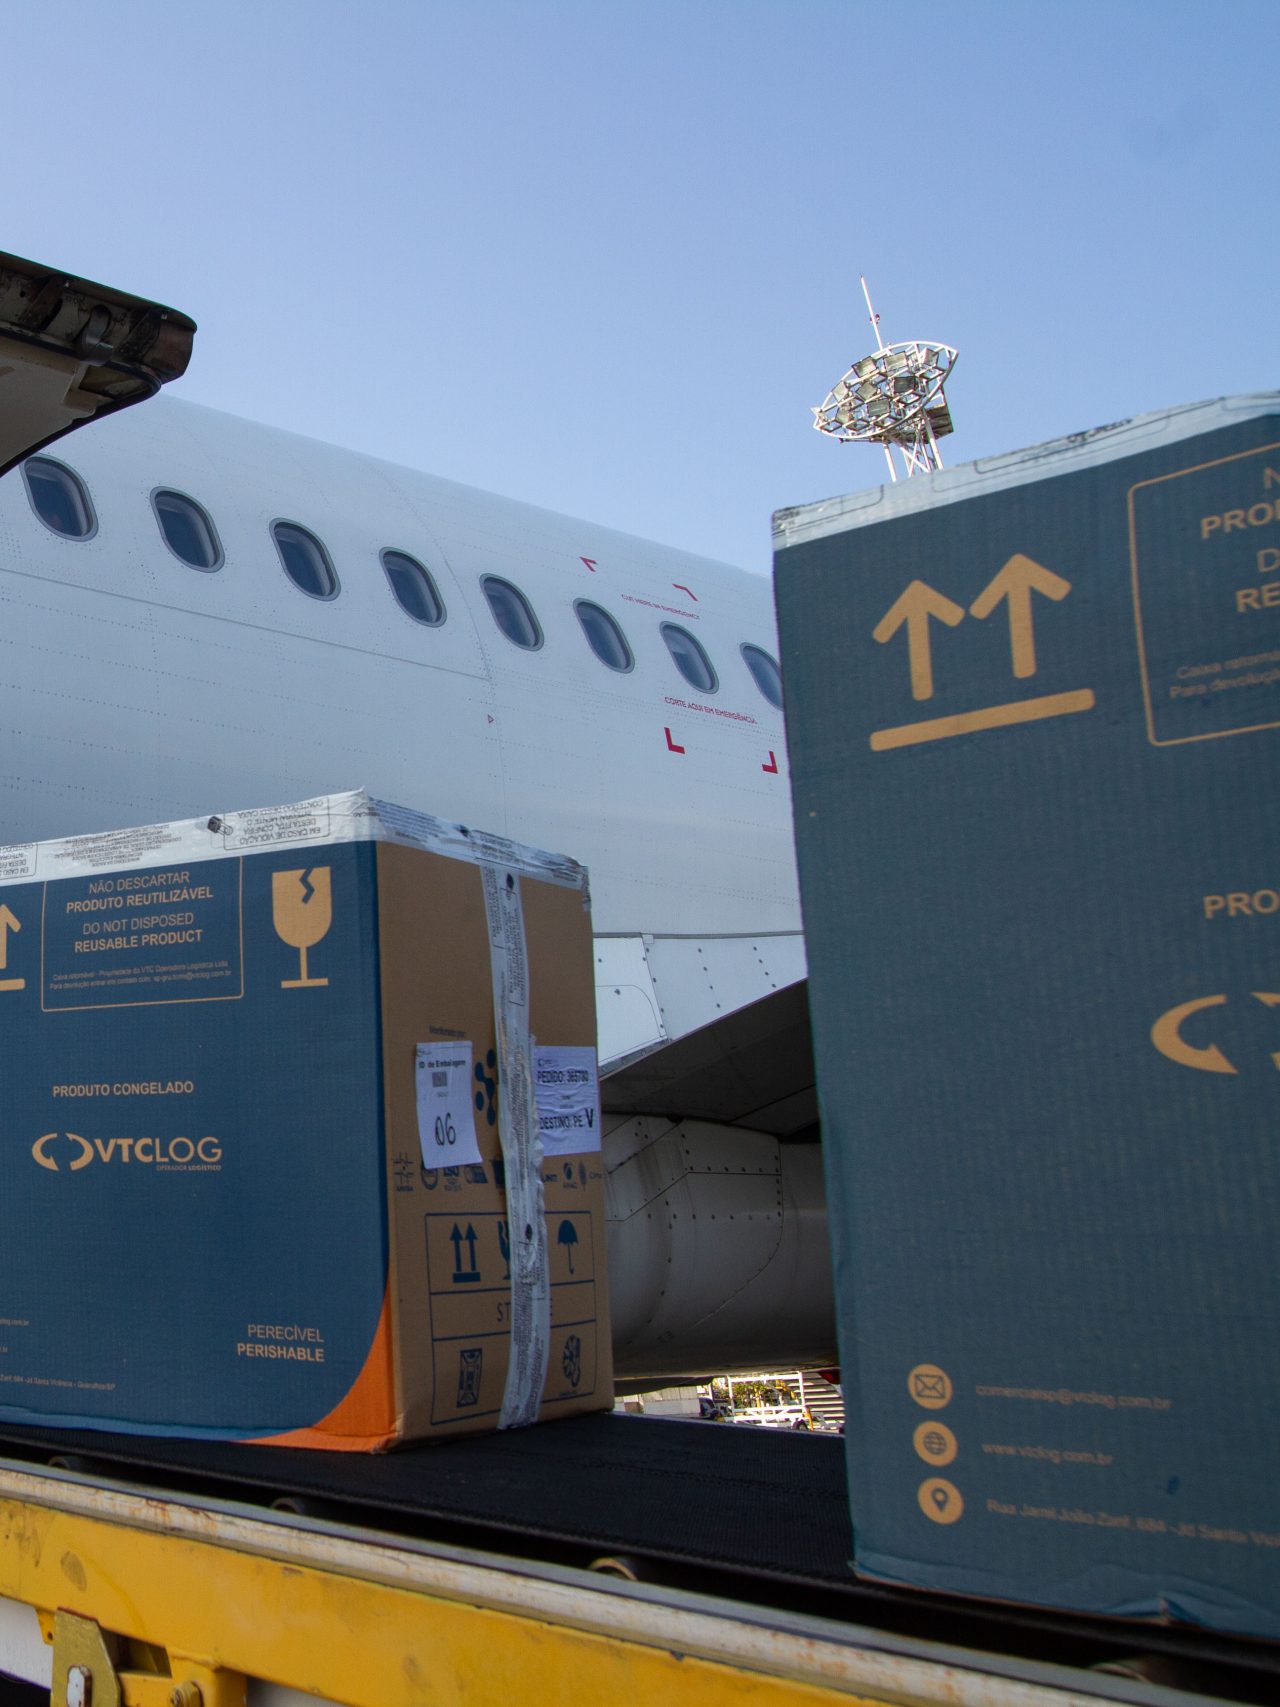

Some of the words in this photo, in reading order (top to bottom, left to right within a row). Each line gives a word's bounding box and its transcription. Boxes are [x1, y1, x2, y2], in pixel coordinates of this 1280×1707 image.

[89, 879, 114, 894] NÃO
[116, 871, 190, 892] DESCARTAR
[66, 896, 123, 913] PRODUTO
[126, 886, 214, 907] REUTILIZÁVEL
[83, 922, 100, 935] DO
[103, 919, 128, 933] NOT
[131, 912, 194, 930] DISPOSED
[75, 935, 138, 953] REUSABLE
[142, 929, 203, 946] PRODUCT
[52, 1083, 110, 1098] PRODUTO
[113, 1080, 195, 1096] CONGELADO
[435, 1112, 457, 1147] 06
[93, 1136, 223, 1163] VTCLOG
[247, 1323, 325, 1343] PERECÍVEL
[236, 1342, 325, 1362] PERISHABLE
